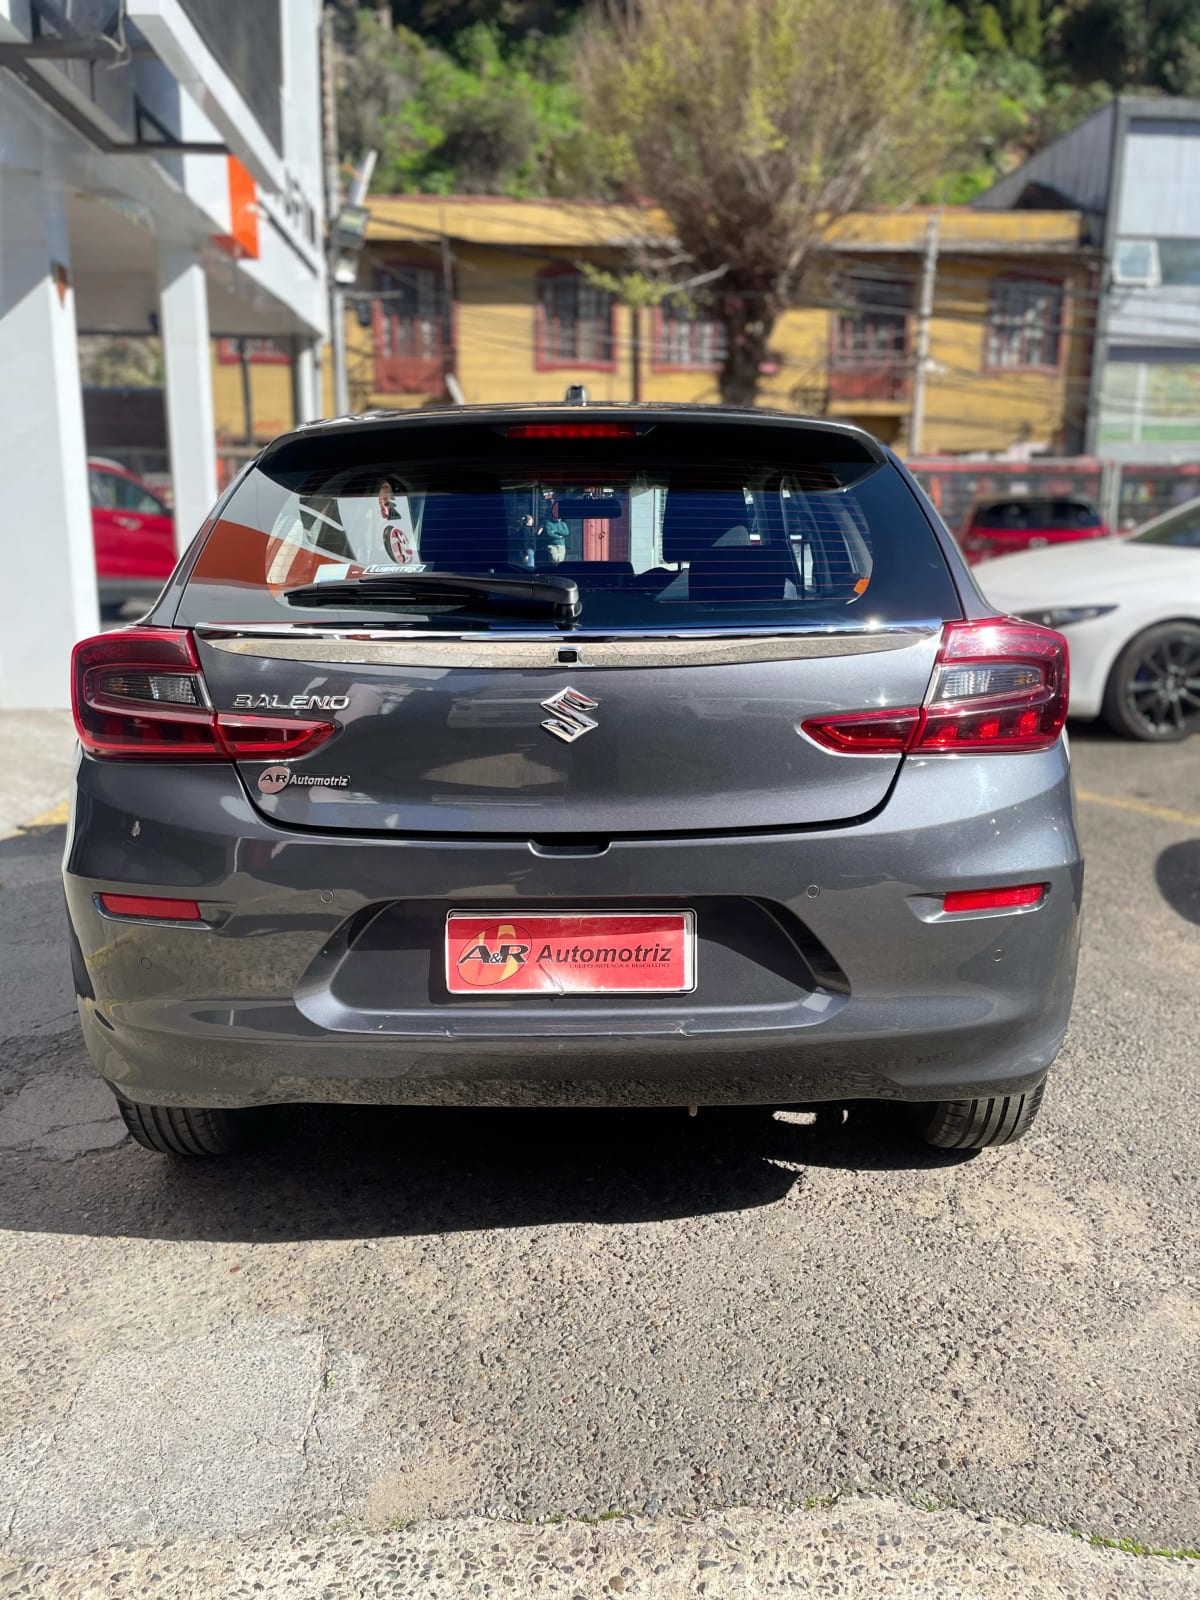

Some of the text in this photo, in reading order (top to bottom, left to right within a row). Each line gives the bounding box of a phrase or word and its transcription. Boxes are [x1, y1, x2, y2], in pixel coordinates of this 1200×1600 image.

[231, 693, 350, 710] BALENO
[289, 774, 349, 787] Automotriz
[457, 943, 672, 965] A&R Automotriz
